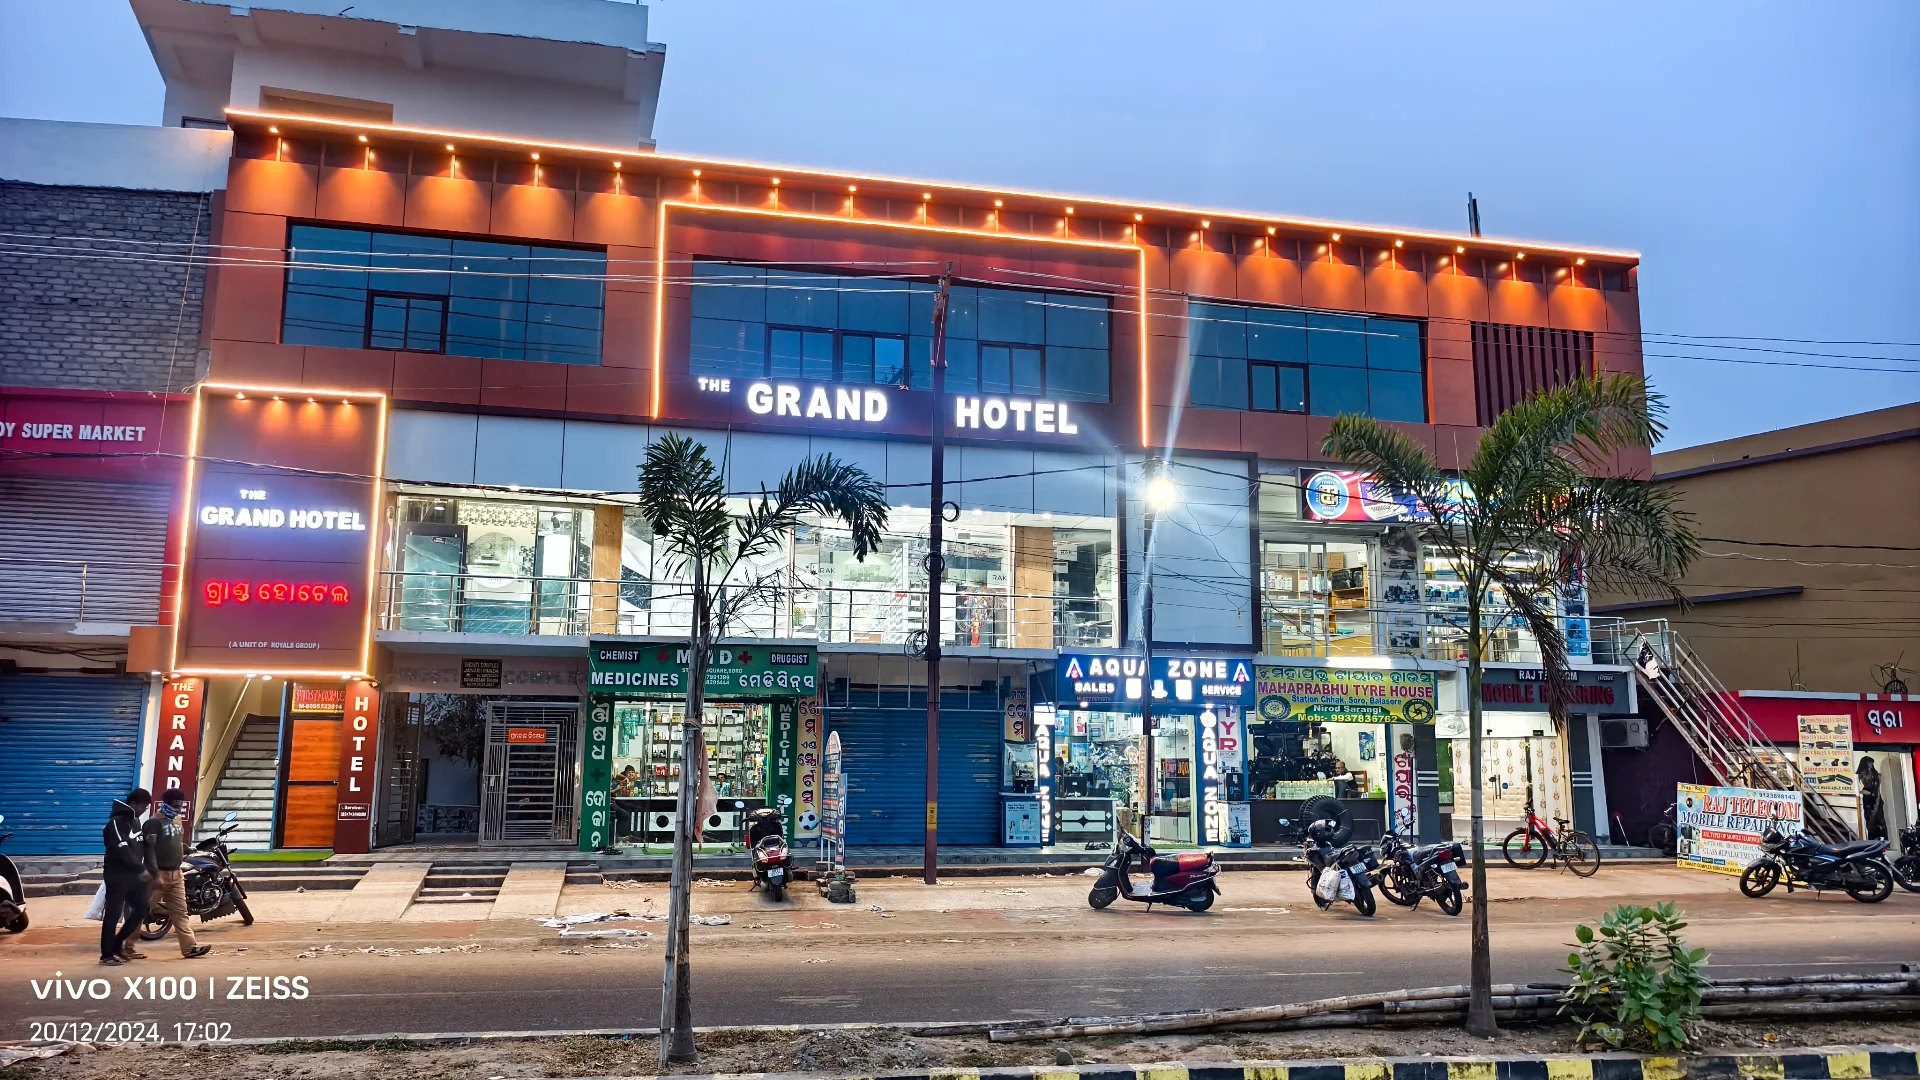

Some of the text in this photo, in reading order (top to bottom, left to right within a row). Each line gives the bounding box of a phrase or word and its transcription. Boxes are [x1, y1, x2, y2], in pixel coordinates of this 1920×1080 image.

[698, 378, 1078, 434] THE GRAND HOTEL
[22, 423, 73, 439] SUPER
[79, 425, 146, 441] MARKET
[240, 489, 267, 500] THE
[201, 506, 366, 531] GRAND HOTEL
[600, 650, 639, 661] CHEMIST
[771, 653, 808, 664] DRUGGIST
[1168, 660, 1227, 678] ZONE
[1519, 670, 1536, 680] RAJ
[172, 682, 194, 692] THE
[591, 671, 679, 687] MEDICINES
[1075, 682, 1115, 693] SALES
[1202, 685, 1242, 696] SERVICE
[1257, 681, 1433, 698] MAHAPRABHU TYRE HOUSE
[1481, 683, 1535, 703] MOBILE
[1291, 694, 1319, 703] Station
[1321, 695, 1346, 705] Chhak,
[1369, 696, 1402, 706] Balasore
[1313, 704, 1382, 715] Nirod Sarangi
[1331, 714, 1398, 723] 9937836762
[167, 693, 190, 790] GRAND
[349, 696, 369, 792] HOTEL
[778, 703, 793, 776] MEDICINE
[1034, 724, 1050, 778] AQUA
[1202, 727, 1218, 780] AQUA
[1204, 787, 1219, 842] ZONE
[1703, 794, 1800, 822] RAJ TELECOM
[1681, 811, 1725, 828] MOBILE
